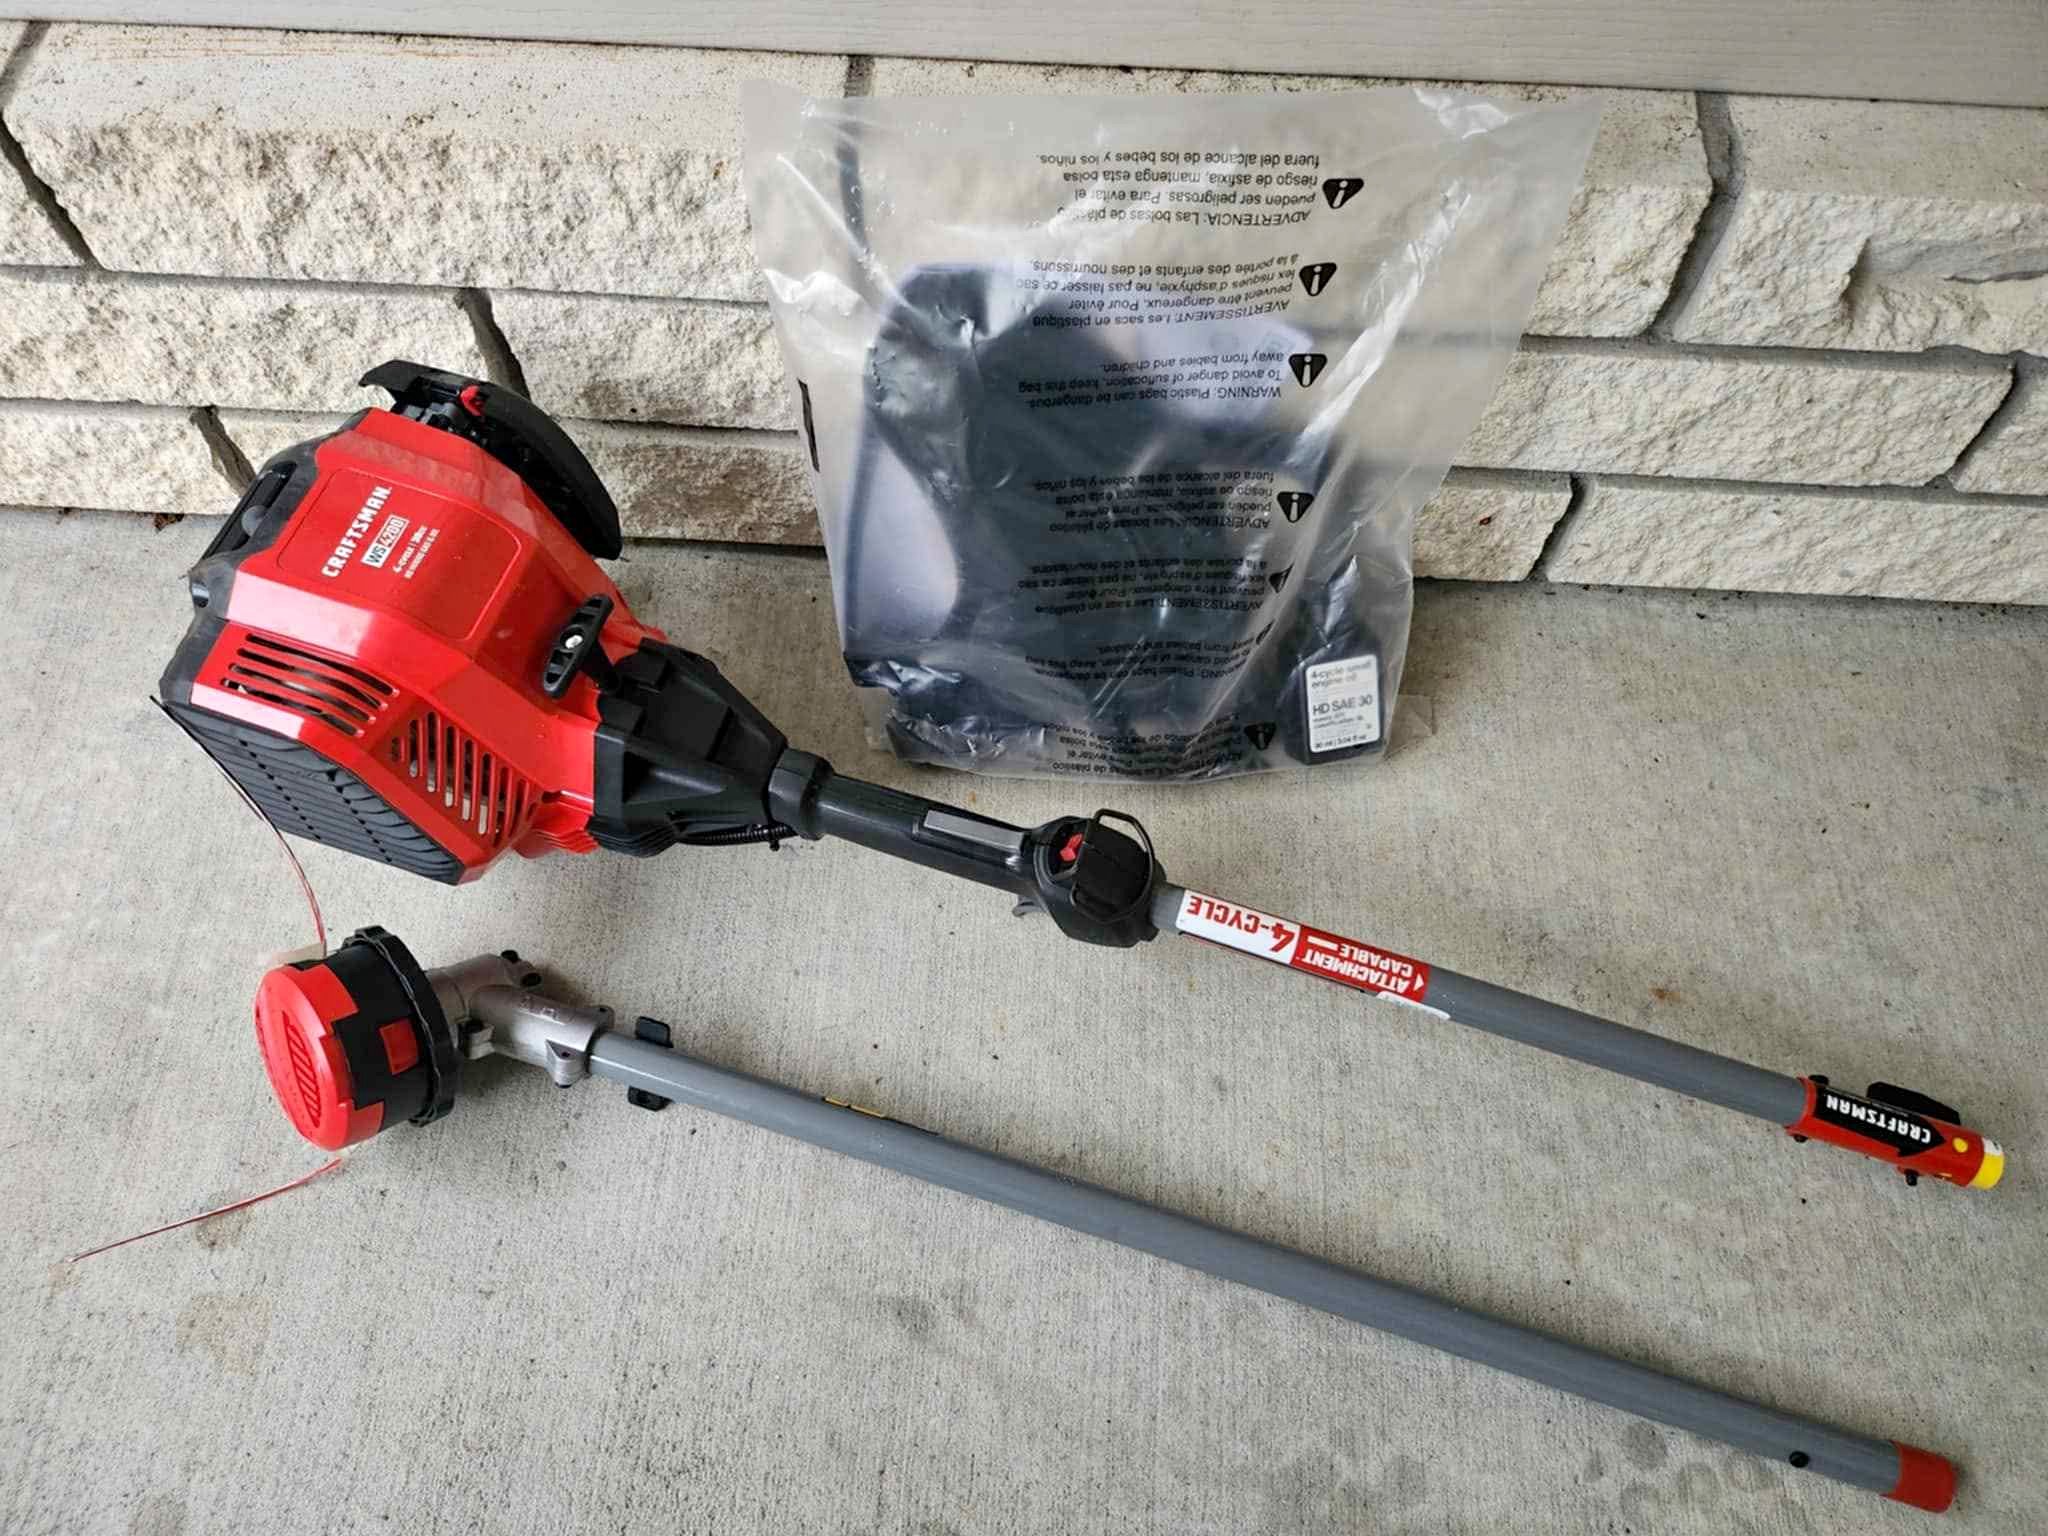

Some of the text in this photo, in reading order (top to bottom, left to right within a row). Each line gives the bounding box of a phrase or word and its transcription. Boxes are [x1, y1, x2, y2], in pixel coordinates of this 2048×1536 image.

[1036, 151, 1320, 170] fuera del alcance de los bebes y los niños.
[1063, 169, 1318, 189] riesgo de asfixia, mantenga esta bolsa
[1074, 189, 1087, 201] el
[1130, 190, 1161, 204] Para
[1166, 190, 1237, 206] peligrosas.
[1240, 195, 1261, 205] ser
[1265, 193, 1316, 208] pueden
[1110, 210, 1127, 223] de
[1176, 211, 1200, 226] Las
[1203, 211, 1311, 226] ADVERTENCIA:
[1111, 264, 1136, 276] des
[1139, 265, 1152, 276] et
[1155, 265, 1204, 276] enfants
[1208, 264, 1231, 275] des
[1015, 279, 1039, 290] sac
[1061, 280, 1104, 295] laisser
[1108, 279, 1132, 292] pas
[1135, 282, 1152, 293] ne
[1245, 283, 1293, 302] peuvent
[1109, 299, 1139, 311] Pour
[1144, 295, 1215, 310] dangereux.
[1218, 294, 1242, 307] être
[1175, 299, 1290, 324] AVERTISSEMENT:
[1032, 314, 1091, 330] plastique
[1095, 316, 1111, 327] en
[1115, 315, 1144, 325] sacs
[1100, 350, 1284, 375] away from babies and chdren.
[1172, 373, 1184, 385] of
[1188, 368, 1229, 384] danger
[1232, 369, 1265, 382] avoid
[1268, 369, 1281, 381] To
[1139, 387, 1167, 401] bags
[1170, 387, 1210, 400] Plastic
[1214, 386, 1281, 399] WARNING:
[322, 486, 390, 577] CRAFTSMAN
[1313, 703, 1330, 716] HD
[1332, 696, 1357, 712] SAE
[1187, 895, 1295, 953] 4-CYCLE
[1339, 943, 1413, 977] CAPABLE
[1302, 949, 1410, 993] ATTACHMENT
[1826, 1095, 1932, 1144] CRAFTSMAN
